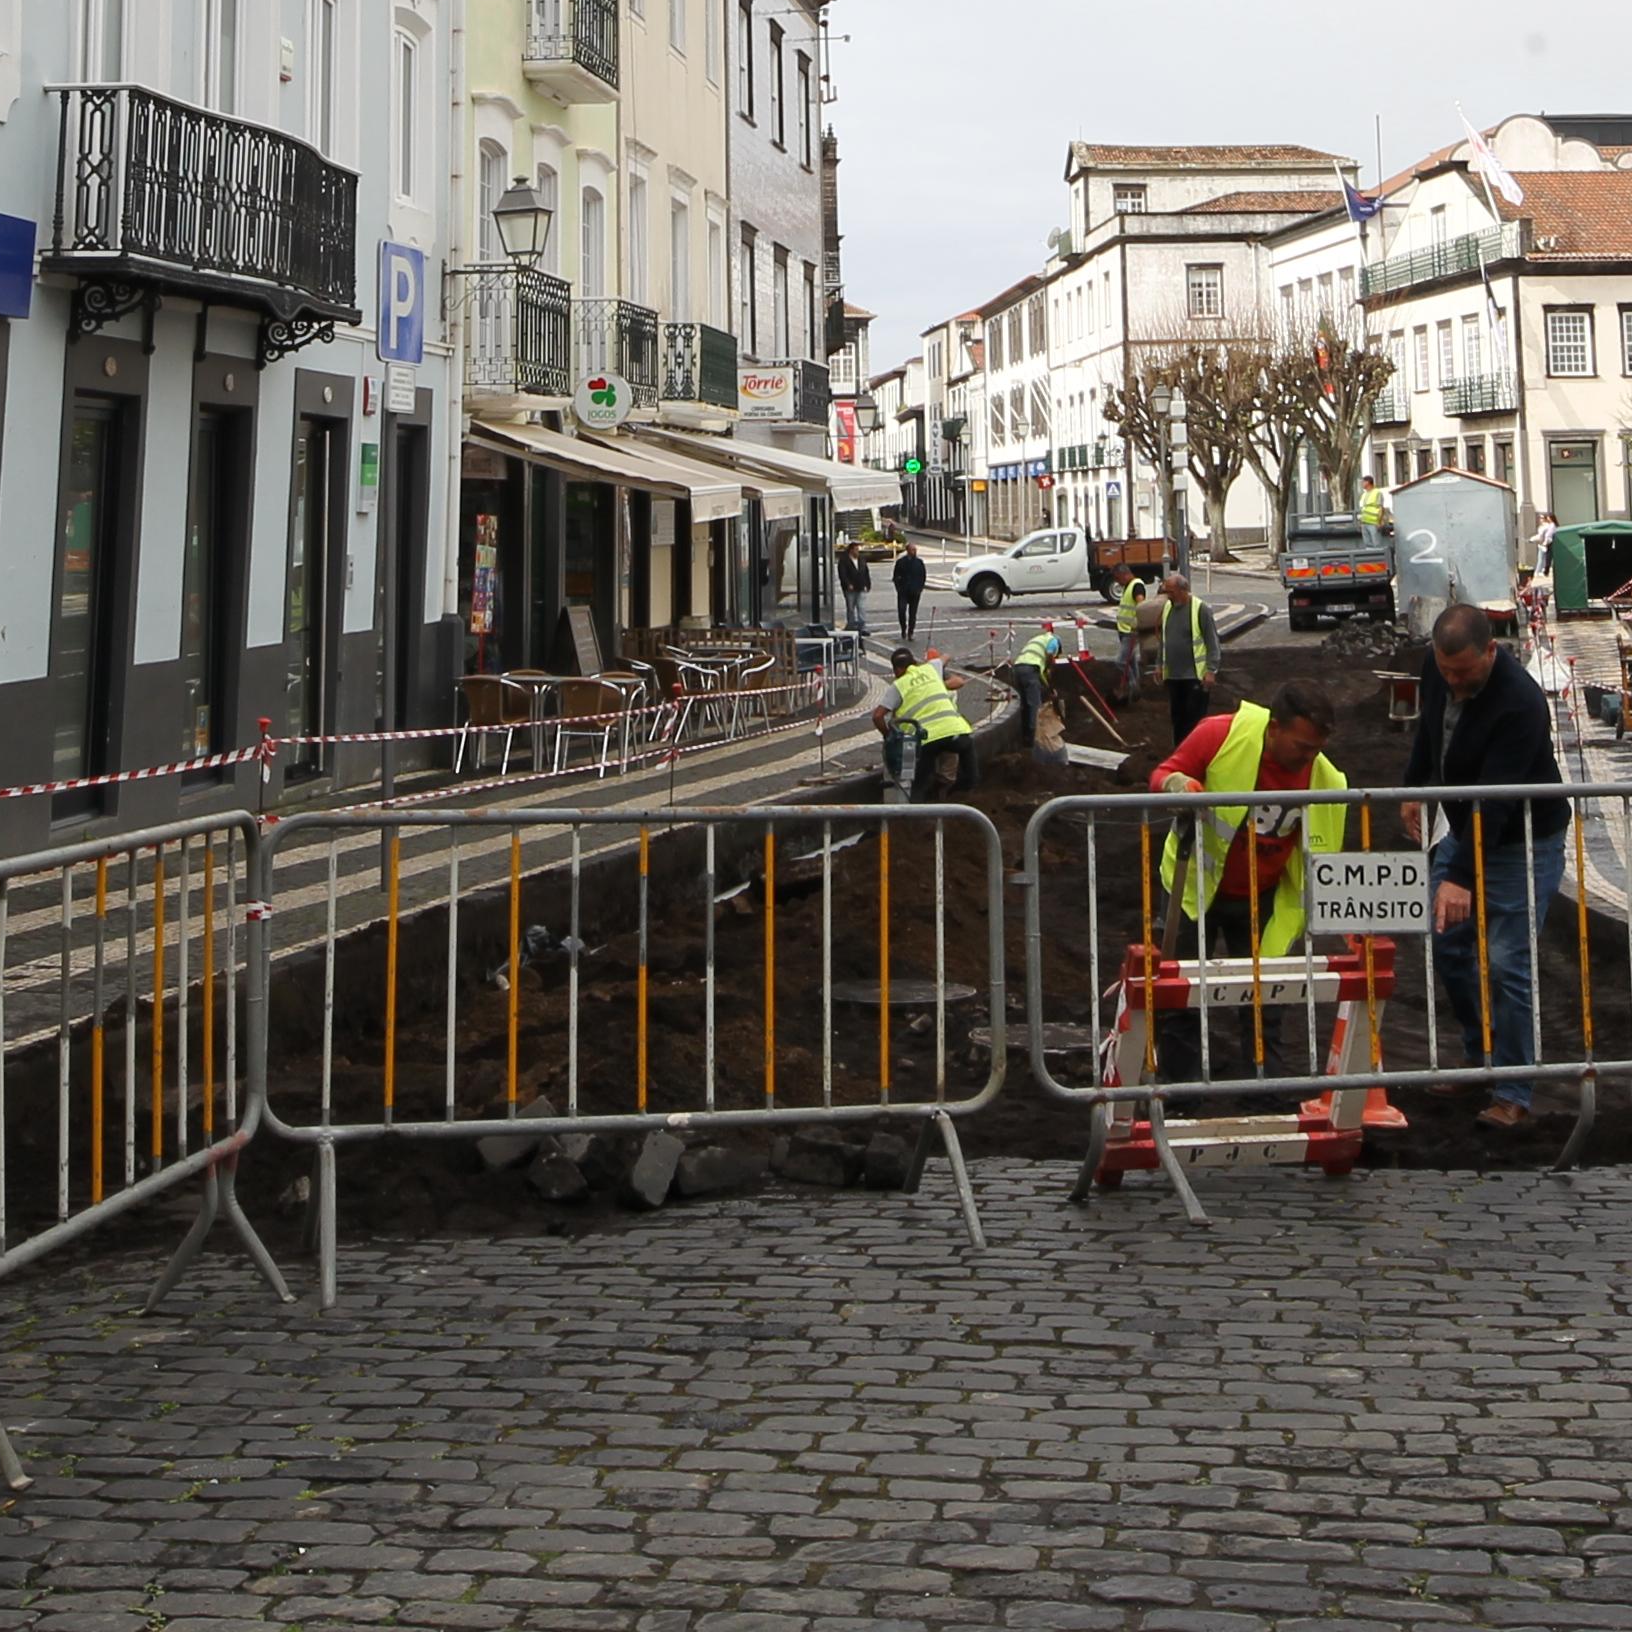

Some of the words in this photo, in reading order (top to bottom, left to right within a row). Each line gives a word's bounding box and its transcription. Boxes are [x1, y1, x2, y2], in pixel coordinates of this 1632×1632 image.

[389, 255, 416, 350] P
[1405, 528, 1444, 564] 2
[1316, 863, 1426, 888] C.M.P.D.
[1317, 896, 1424, 920] TRÂNSITO
